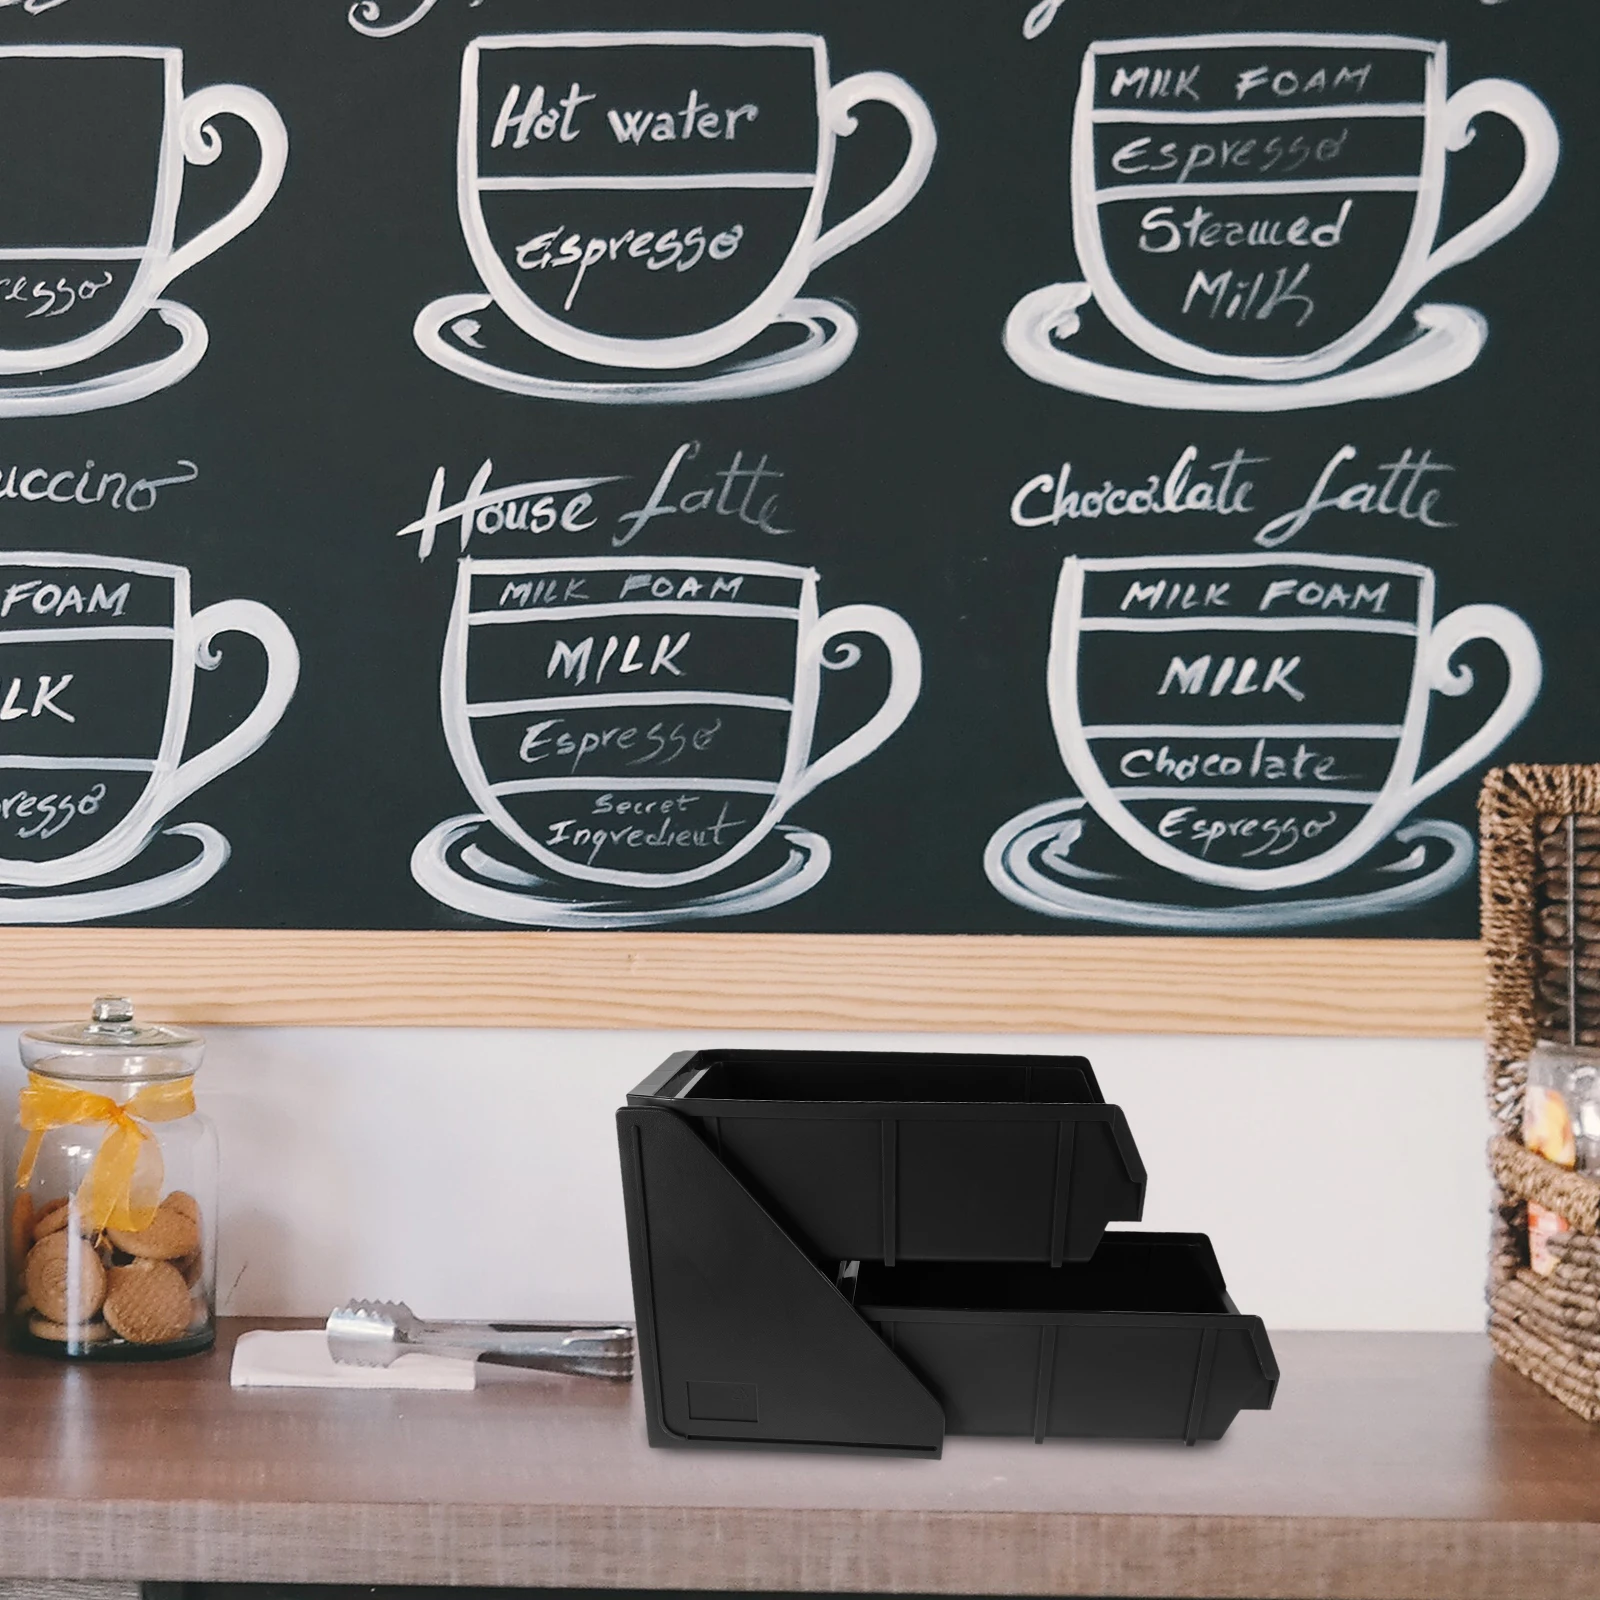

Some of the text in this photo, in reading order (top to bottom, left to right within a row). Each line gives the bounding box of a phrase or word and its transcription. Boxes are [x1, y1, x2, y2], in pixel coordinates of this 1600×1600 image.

[1110, 64, 1372, 100] MILK FOAM
[491, 83, 759, 149] Hot water
[1111, 129, 1348, 183] Espresso
[1138, 199, 1353, 253] Steamed
[515, 224, 744, 311] Espresso
[1182, 263, 1314, 326] Milk
[395, 440, 797, 563] House Latte
[1010, 444, 1458, 548] Chocolate Latte
[0, 580, 131, 617] FOAM
[499, 573, 744, 607] MILK FOAM
[1120, 579, 1391, 613] MILK FOAM
[547, 632, 691, 687] MILK
[1157, 655, 1306, 702] MILK
[519, 718, 722, 774] Espresso
[1120, 739, 1362, 781] Chocolate
[0, 783, 107, 840] resso
[591, 793, 699, 815] Secret
[1157, 806, 1338, 859] Espresso
